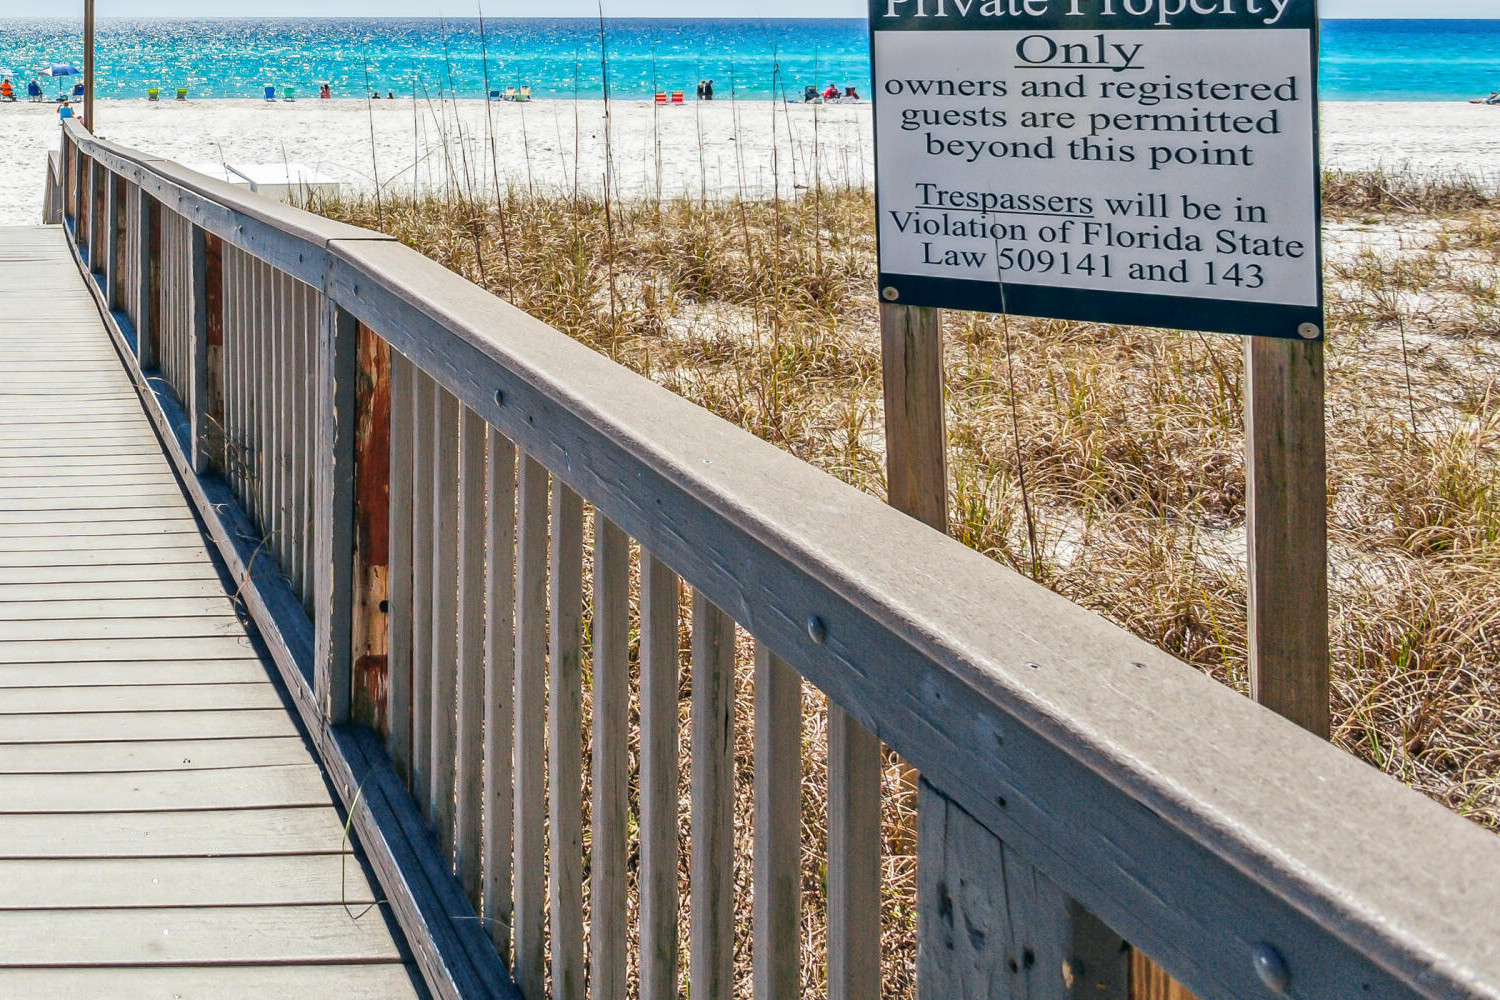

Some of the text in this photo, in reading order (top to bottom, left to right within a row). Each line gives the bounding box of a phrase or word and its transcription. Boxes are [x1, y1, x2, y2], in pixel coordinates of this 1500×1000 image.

[1015, 34, 1144, 72] Only
[884, 75, 1300, 105] owners and registered
[901, 107, 1281, 136] guests are permitted
[925, 133, 1254, 170] beyond this point
[915, 183, 1268, 223] Trespassers will be in
[891, 211, 1305, 258] Violation of Florida State
[922, 243, 1264, 288] Law 509141 and 143
